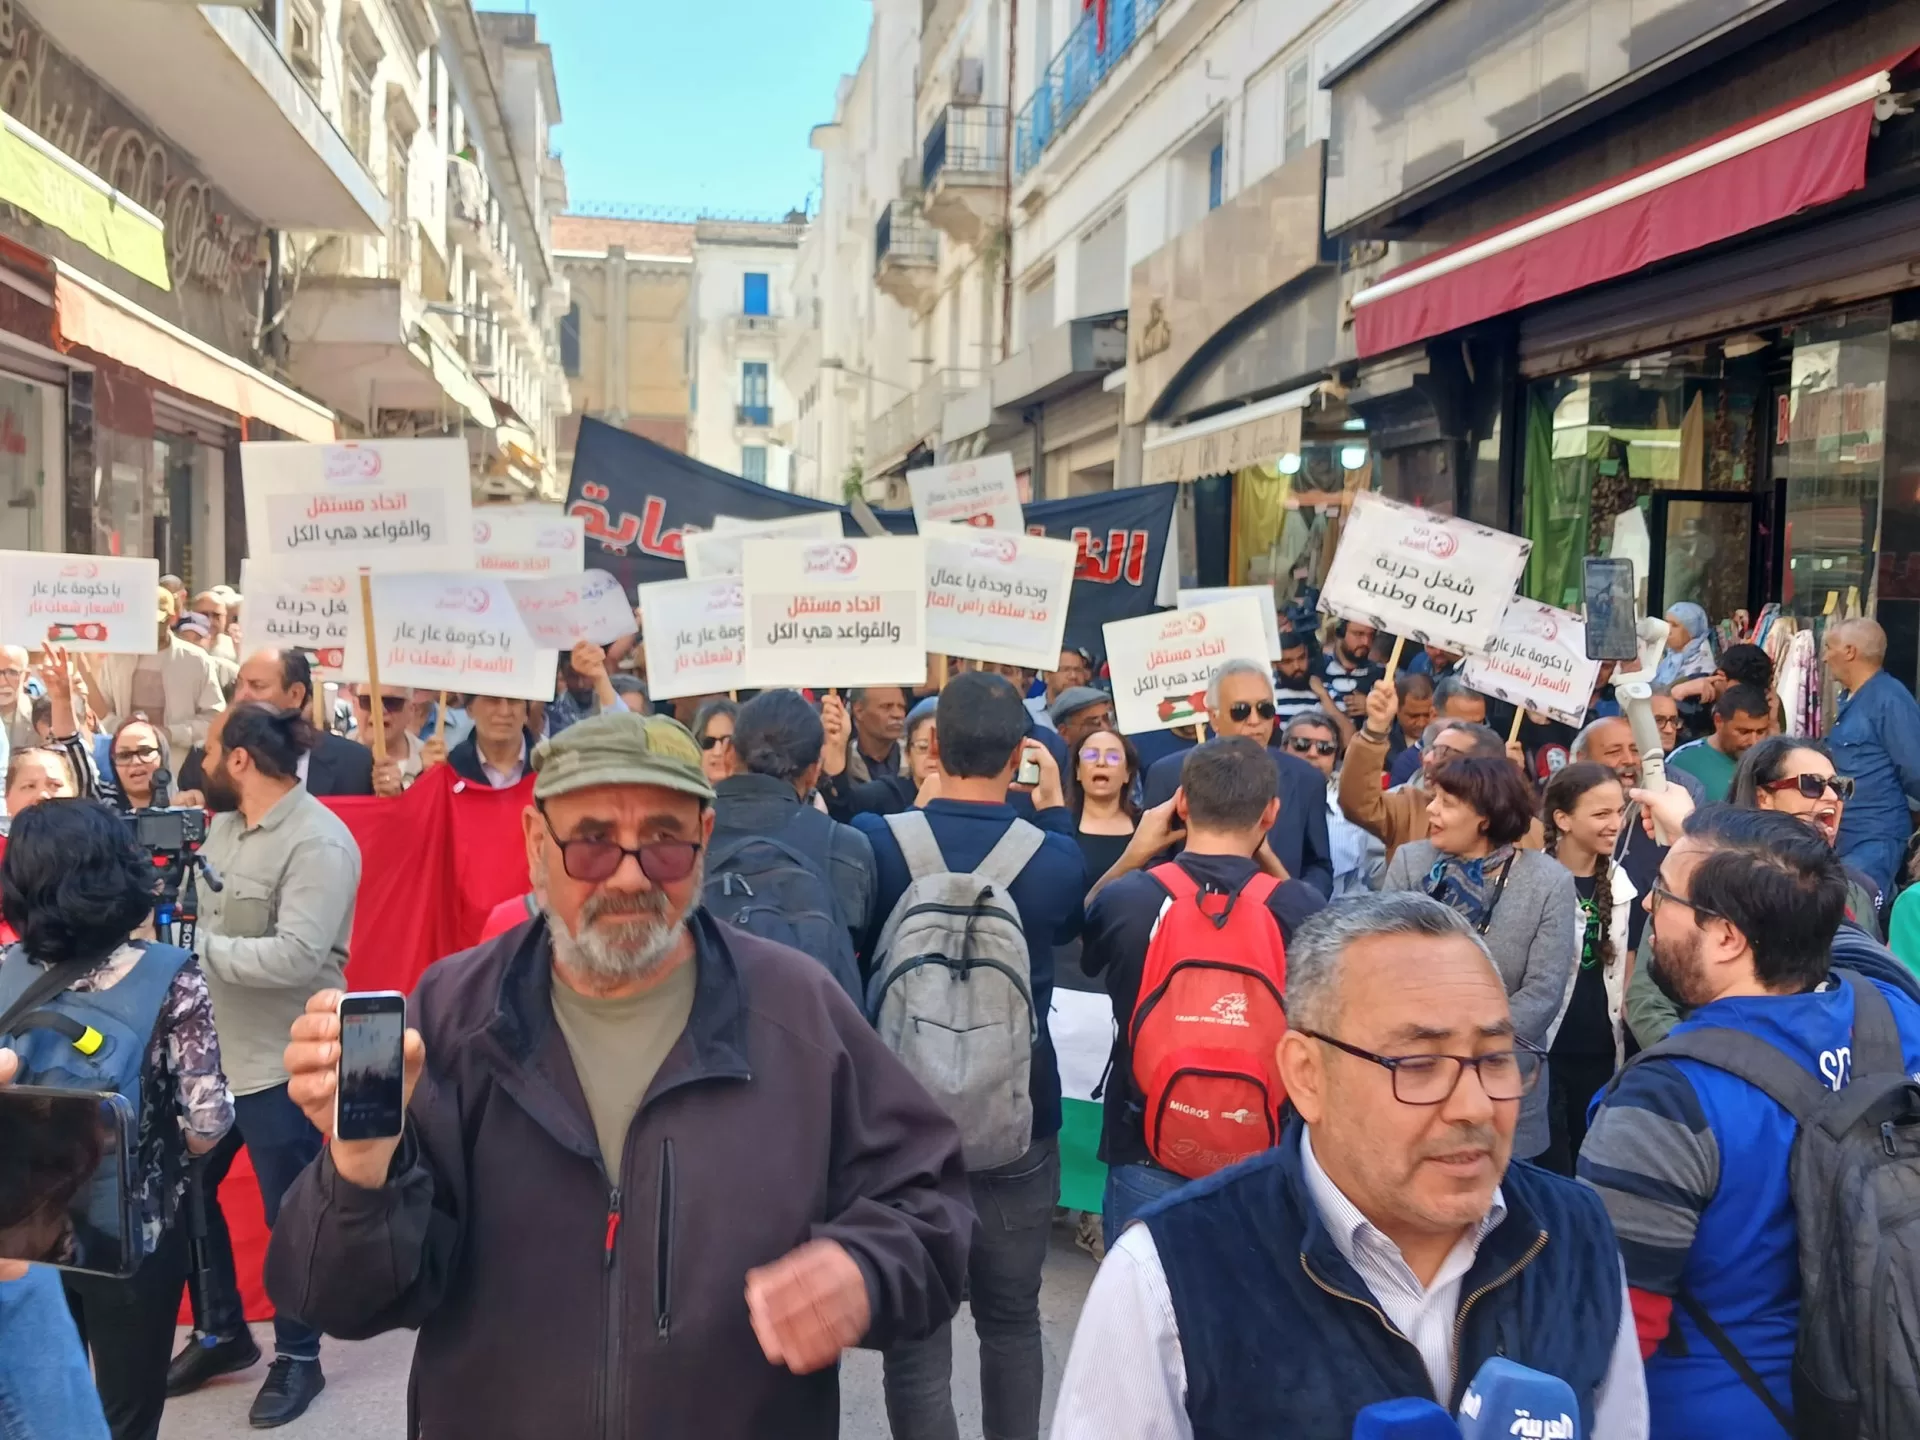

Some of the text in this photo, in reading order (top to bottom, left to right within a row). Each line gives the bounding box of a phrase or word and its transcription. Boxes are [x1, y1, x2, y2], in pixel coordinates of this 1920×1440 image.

[307, 493, 407, 518] اتحاد مستقل
[287, 519, 431, 548] والقواعد هي الكل
[931, 567, 962, 588] عمال
[966, 573, 976, 593] يا
[1375, 552, 1475, 597] شغل حرية
[32, 579, 121, 599] يا حكومة عار عار
[978, 575, 1012, 598] وحدة
[276, 595, 348, 618] غل حرية
[787, 594, 881, 618] اتحاد مستقل
[987, 599, 1025, 618] سلطة
[1357, 573, 1478, 625] كرامة وطنية
[1029, 607, 1047, 621] ضد
[267, 619, 320, 641] وطنية
[392, 620, 511, 652] يا حكومة عار عار
[676, 630, 693, 651] عار
[697, 627, 716, 648] عار
[767, 621, 901, 645] والقواعد هي الكل
[1146, 637, 1226, 671] اتحاد مستقل
[1485, 656, 1500, 672] نار
[1494, 637, 1573, 677] يا حكومة عار عار
[1162, 673, 1188, 691] هي
[1501, 663, 1532, 681] شعلت
[1134, 675, 1159, 697] الكل
[1169, 1099, 1210, 1120] MIGROS
[1509, 1408, 1574, 1440] العربية
